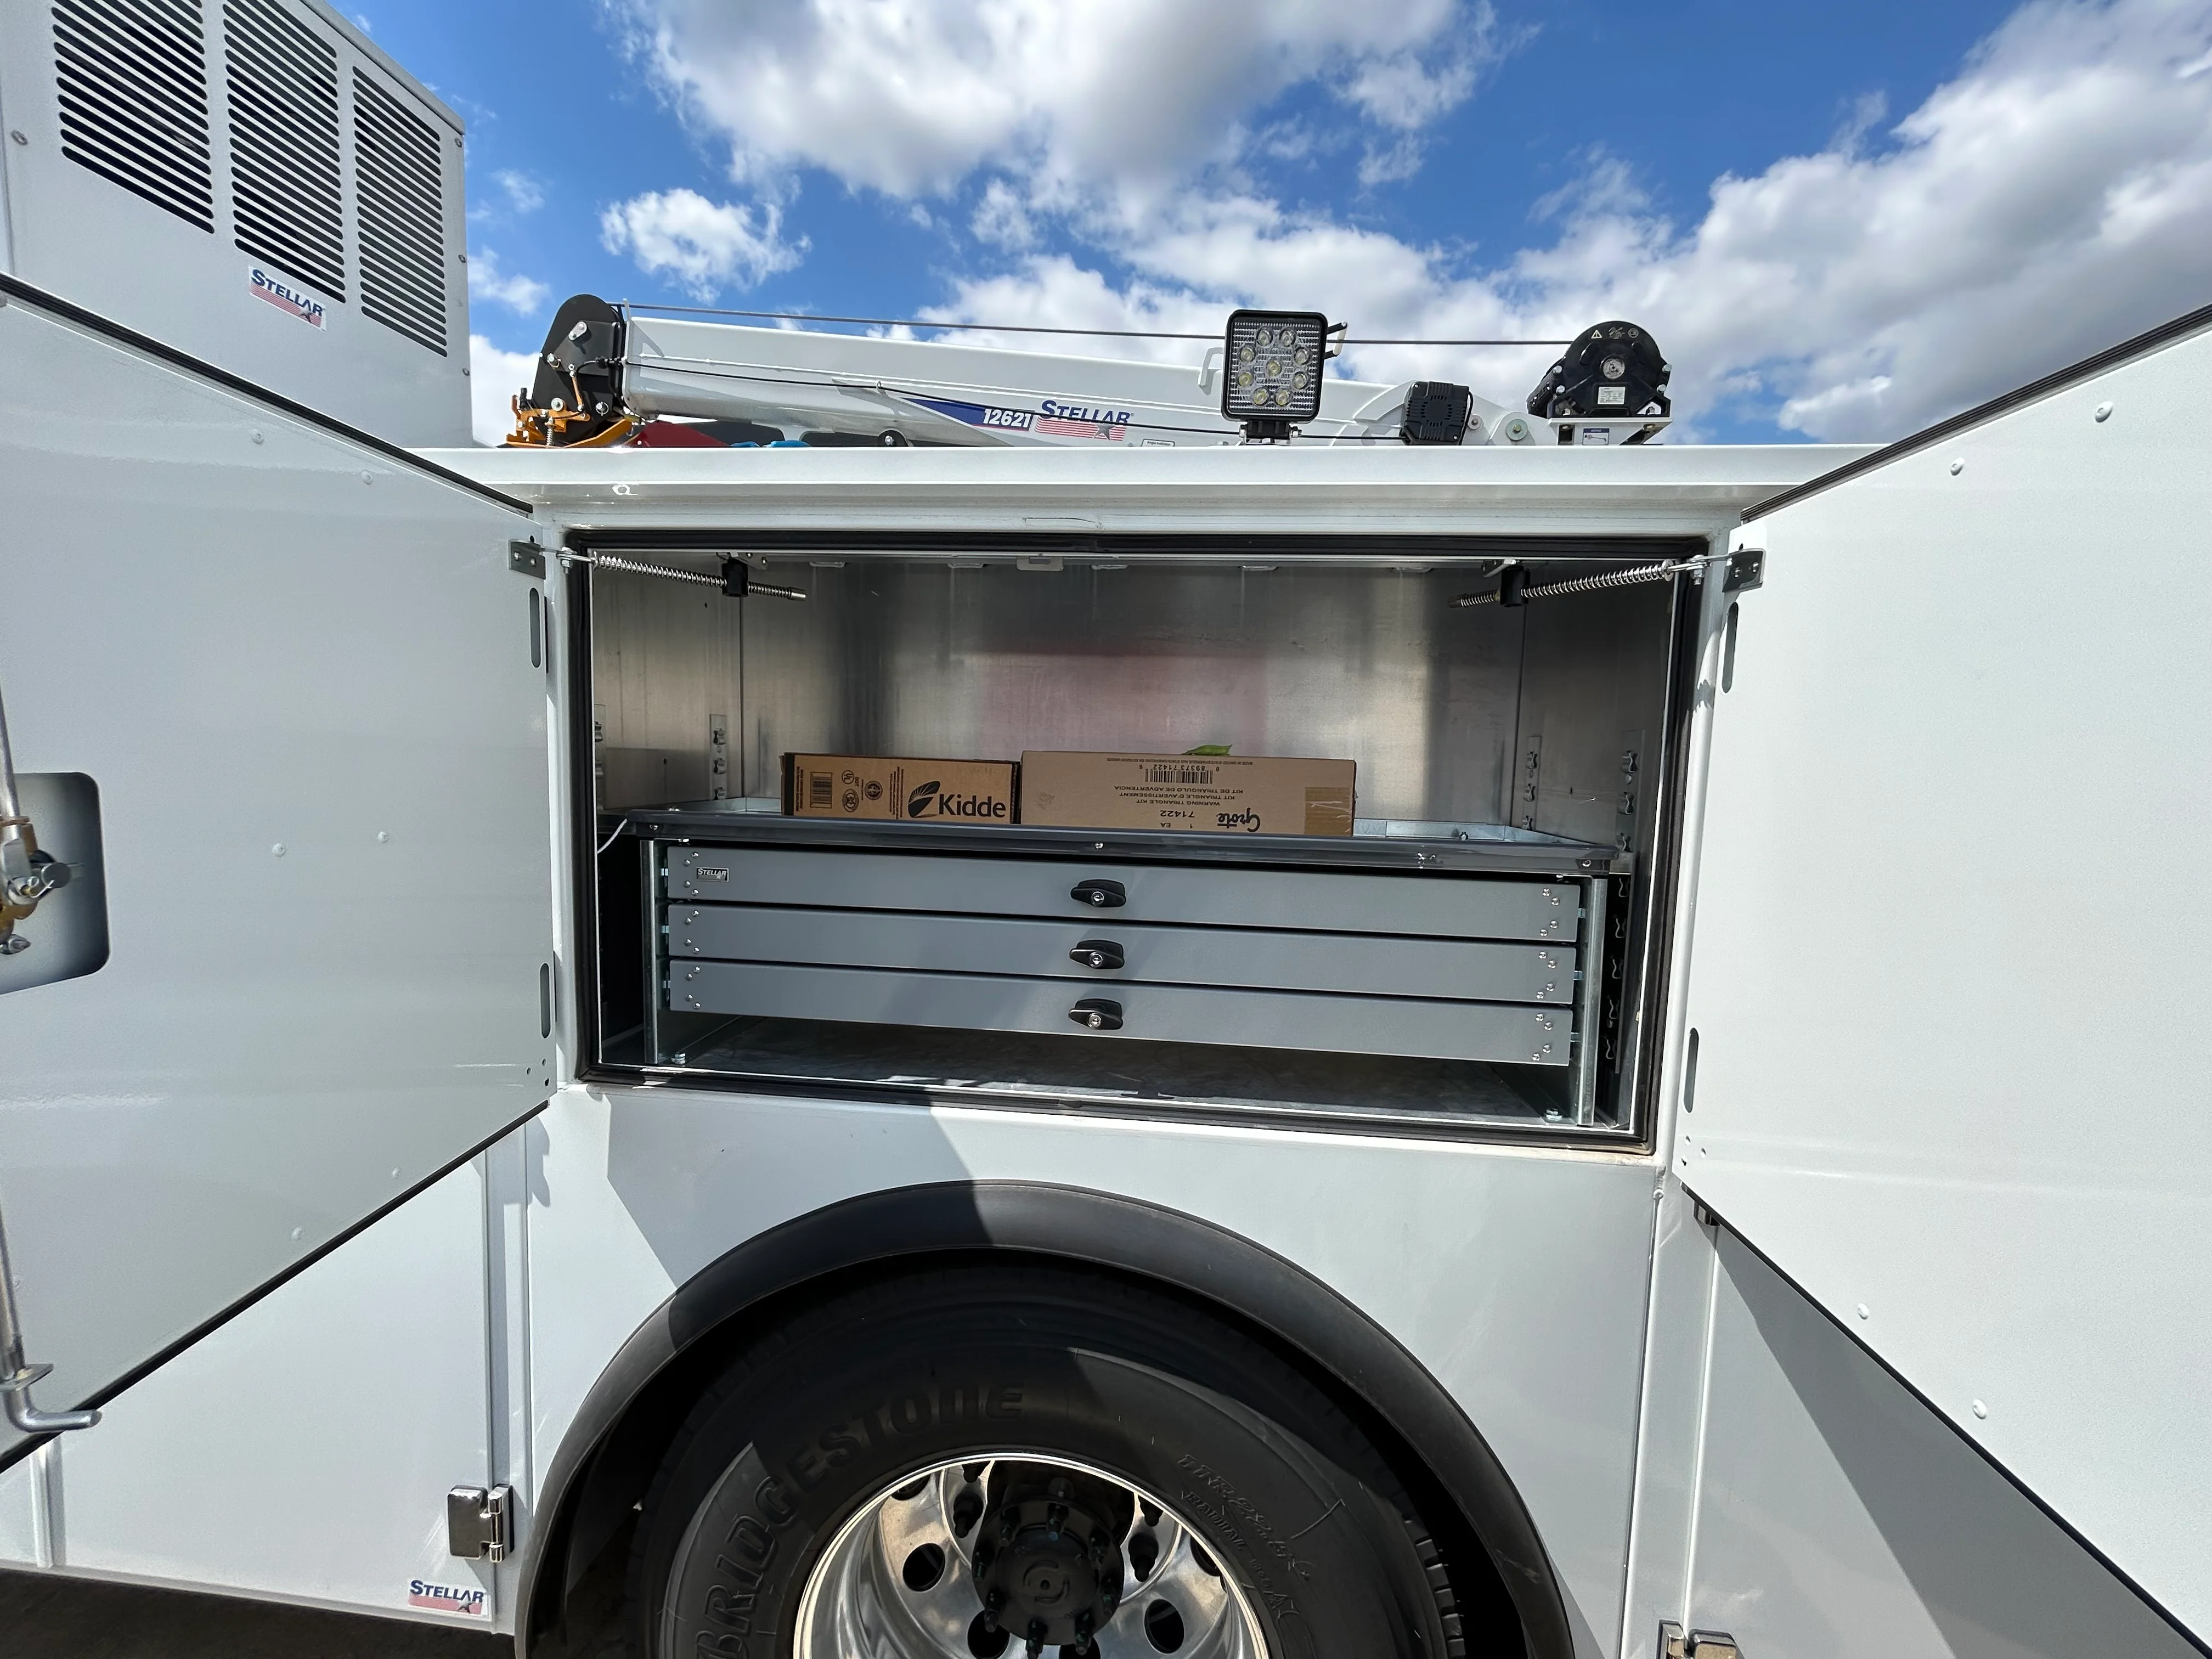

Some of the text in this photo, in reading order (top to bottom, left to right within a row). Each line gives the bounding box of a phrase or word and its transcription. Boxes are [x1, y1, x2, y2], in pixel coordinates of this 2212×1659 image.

[251, 269, 323, 317] STELLAR
[983, 408, 1032, 428] 12621
[1041, 399, 1131, 424] STELLAR
[939, 793, 1006, 818] Kidde
[1160, 810, 1195, 818] 71422
[1217, 807, 1261, 833] Grote
[697, 868, 727, 876] STELLAR
[410, 1579, 484, 1602] STELLAR
